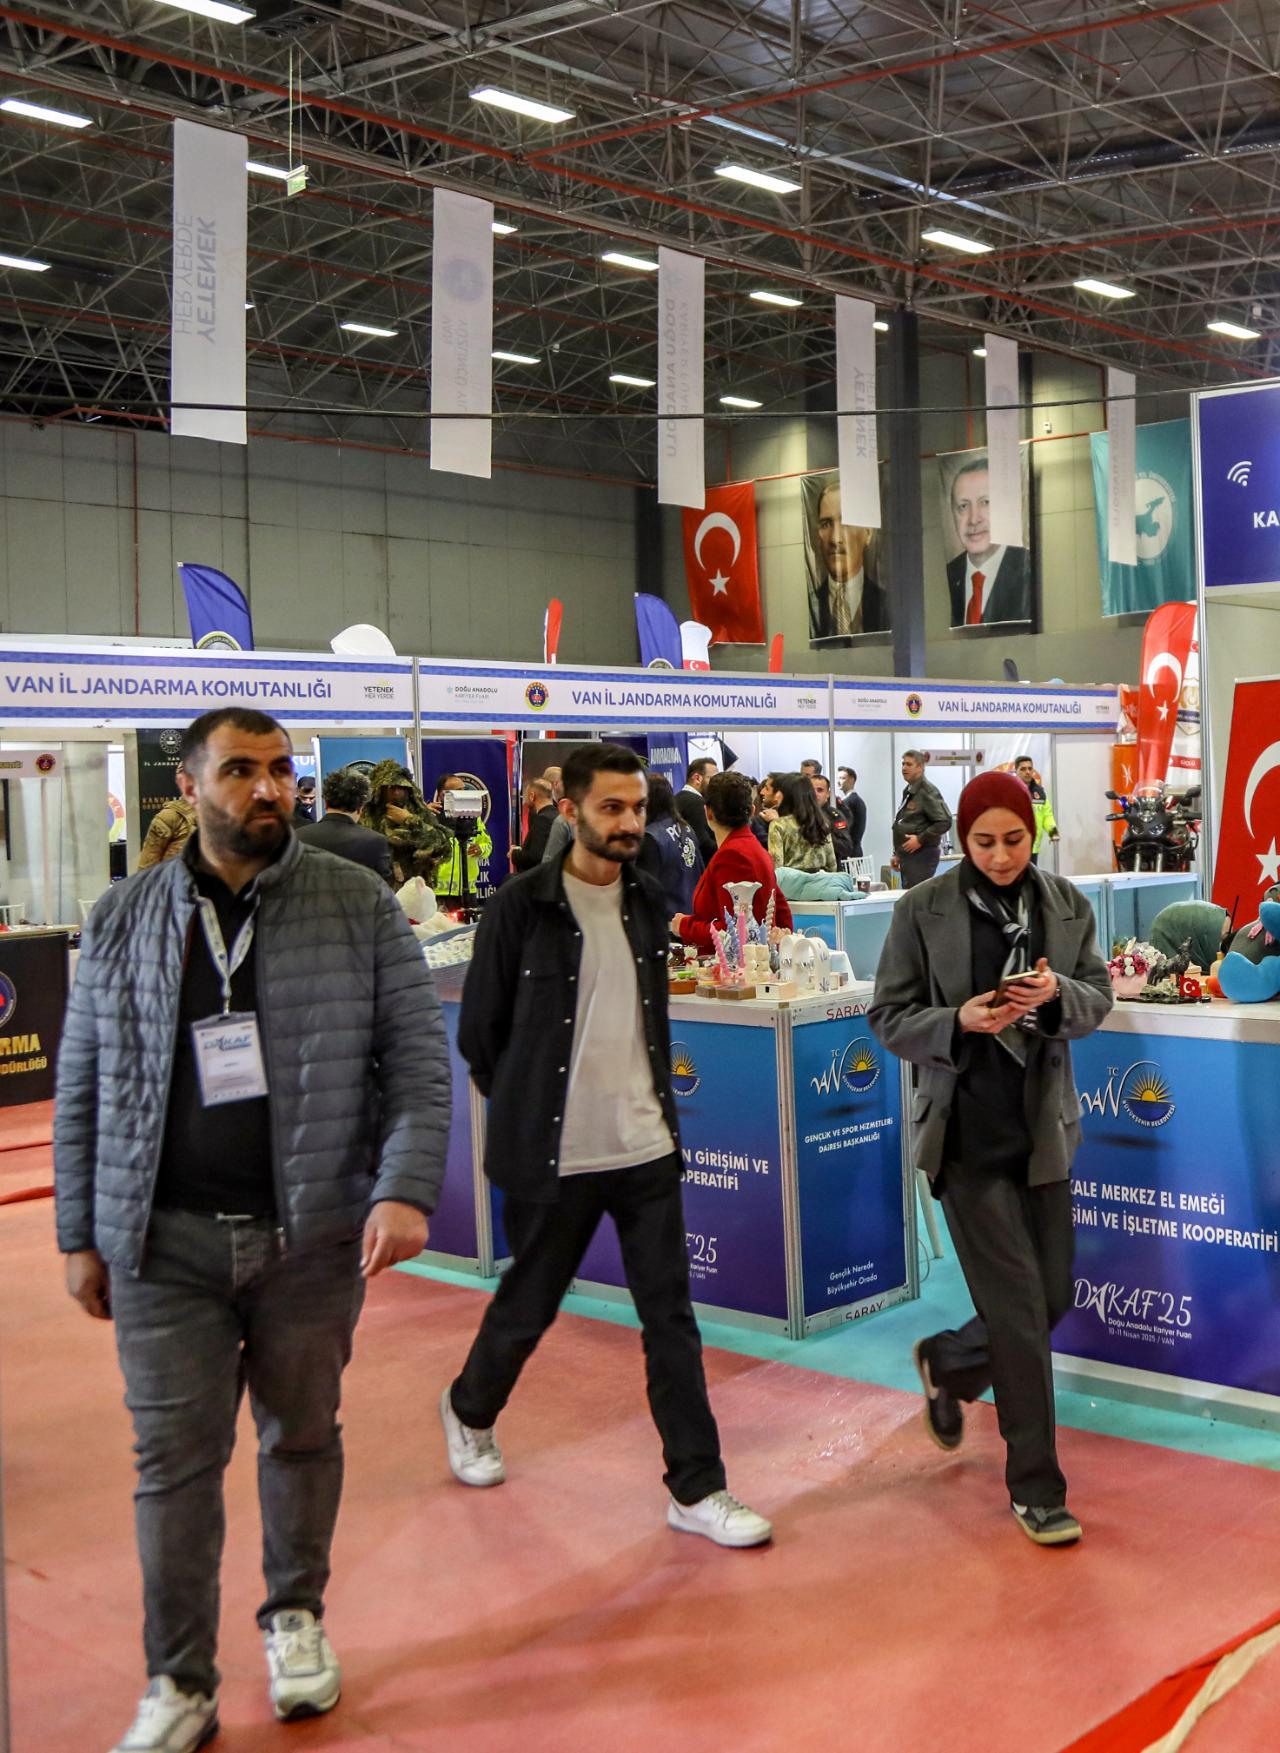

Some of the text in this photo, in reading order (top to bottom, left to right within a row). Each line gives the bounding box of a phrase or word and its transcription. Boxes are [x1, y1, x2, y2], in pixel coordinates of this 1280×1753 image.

[6, 672, 332, 698] VAN İL JANDARMA KOMUTANLIĞI
[572, 688, 777, 709] VAN İL JANDARMA KOMUTANLIĞI
[938, 701, 959, 713] VAN
[960, 699, 969, 713] İL
[970, 701, 1022, 713] JANDARMA
[1023, 701, 1082, 714] KOMUTANLIĞI
[826, 1003, 868, 1020] SARAY
[833, 1129, 841, 1137] VE
[842, 1126, 859, 1135] SPOR
[695, 1148, 769, 1174] GİRİŞİMİ VE
[1101, 1183, 1155, 1206] MERKEZ
[1160, 1191, 1175, 1209] EL
[1180, 1192, 1225, 1215] EMEĞİ
[1101, 1211, 1119, 1230] VE
[1123, 1210, 1178, 1236] İŞLETME
[1182, 1223, 1279, 1252] KOOPERATİFİ
[852, 1260, 874, 1274] Nerede
[858, 1273, 878, 1284] Orada
[845, 1300, 884, 1320] SARAY
[1108, 1318, 1125, 1328] Doğu
[1126, 1320, 1152, 1332] Anadolu
[1161, 1336, 1175, 1345] VAN
